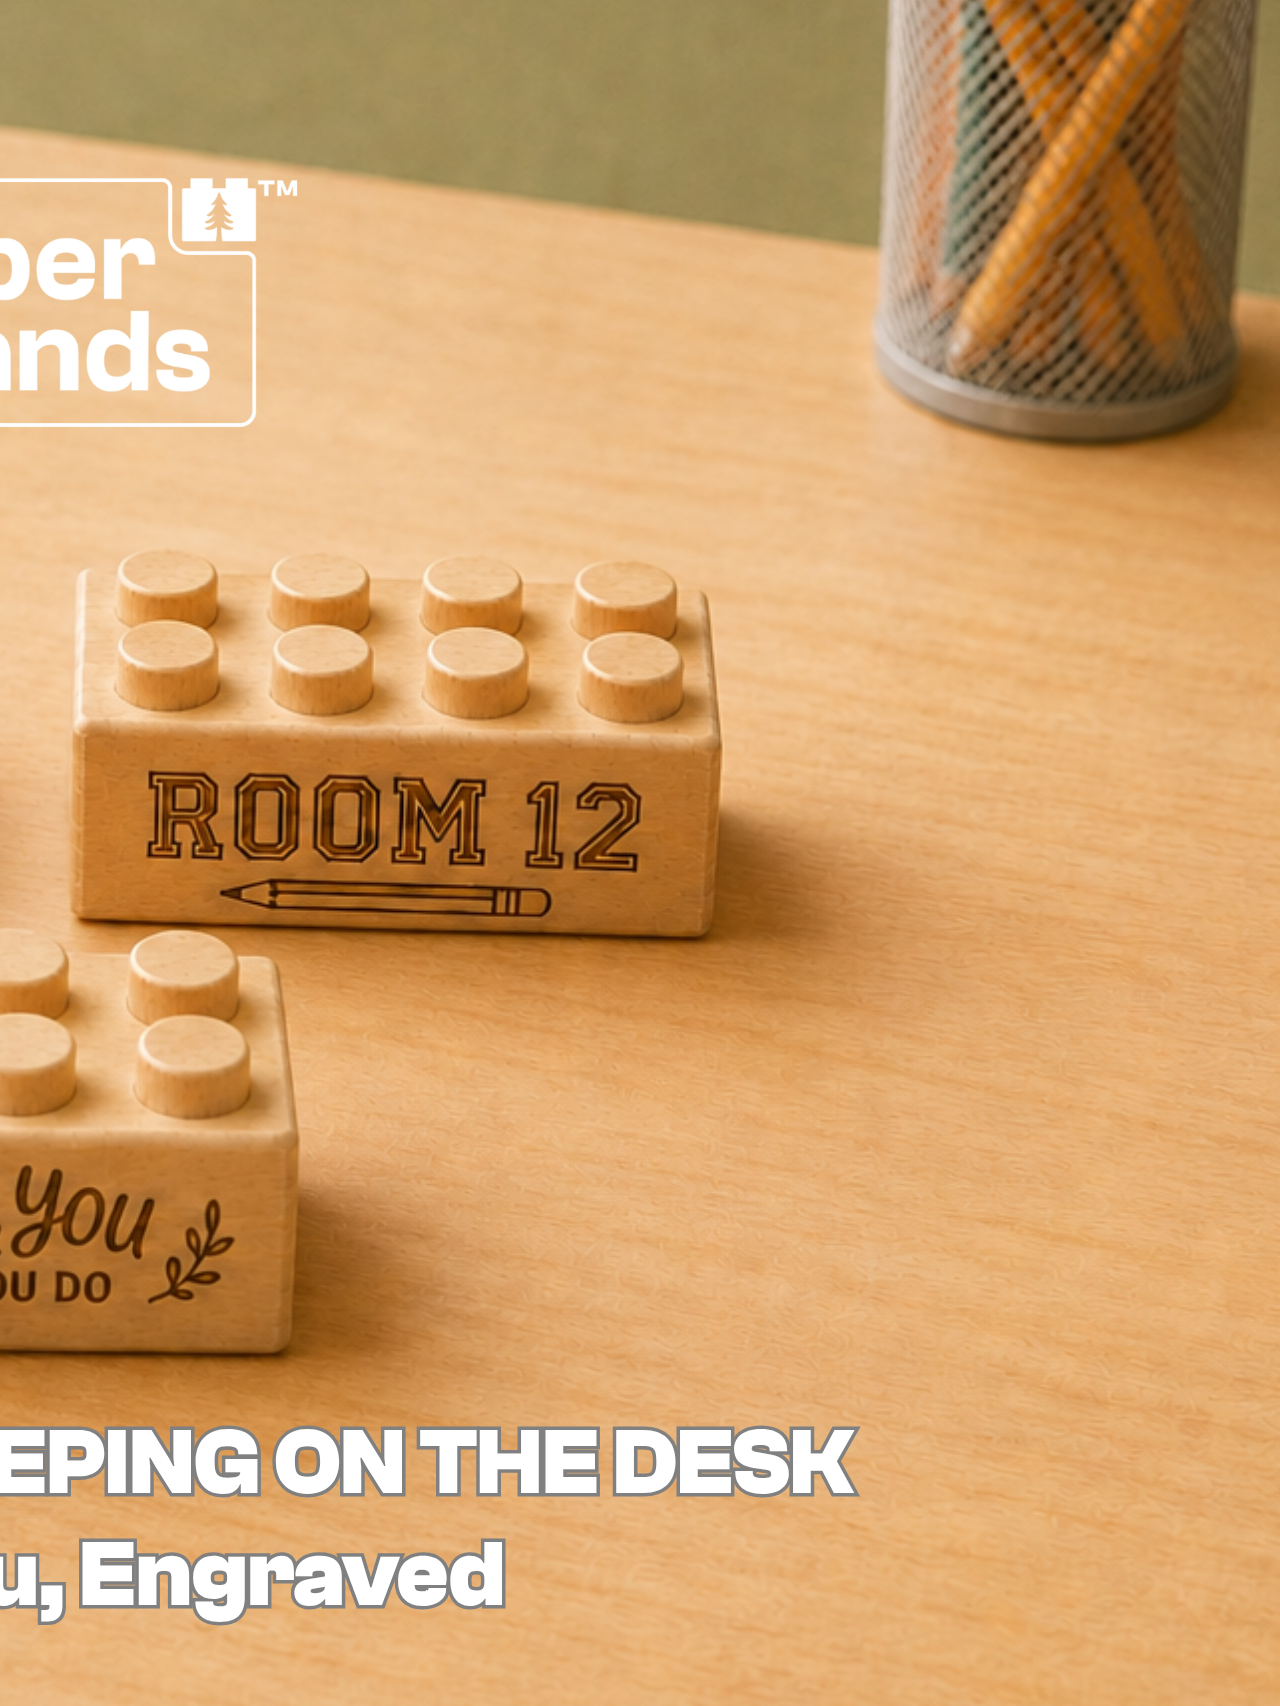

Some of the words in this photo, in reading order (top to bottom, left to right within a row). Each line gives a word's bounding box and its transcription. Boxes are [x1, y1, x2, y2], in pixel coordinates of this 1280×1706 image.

[147, 770, 487, 866] ROOM
[525, 780, 642, 873] 12
[11, 1164, 156, 1259] YOU
[54, 1270, 113, 1304] DO
